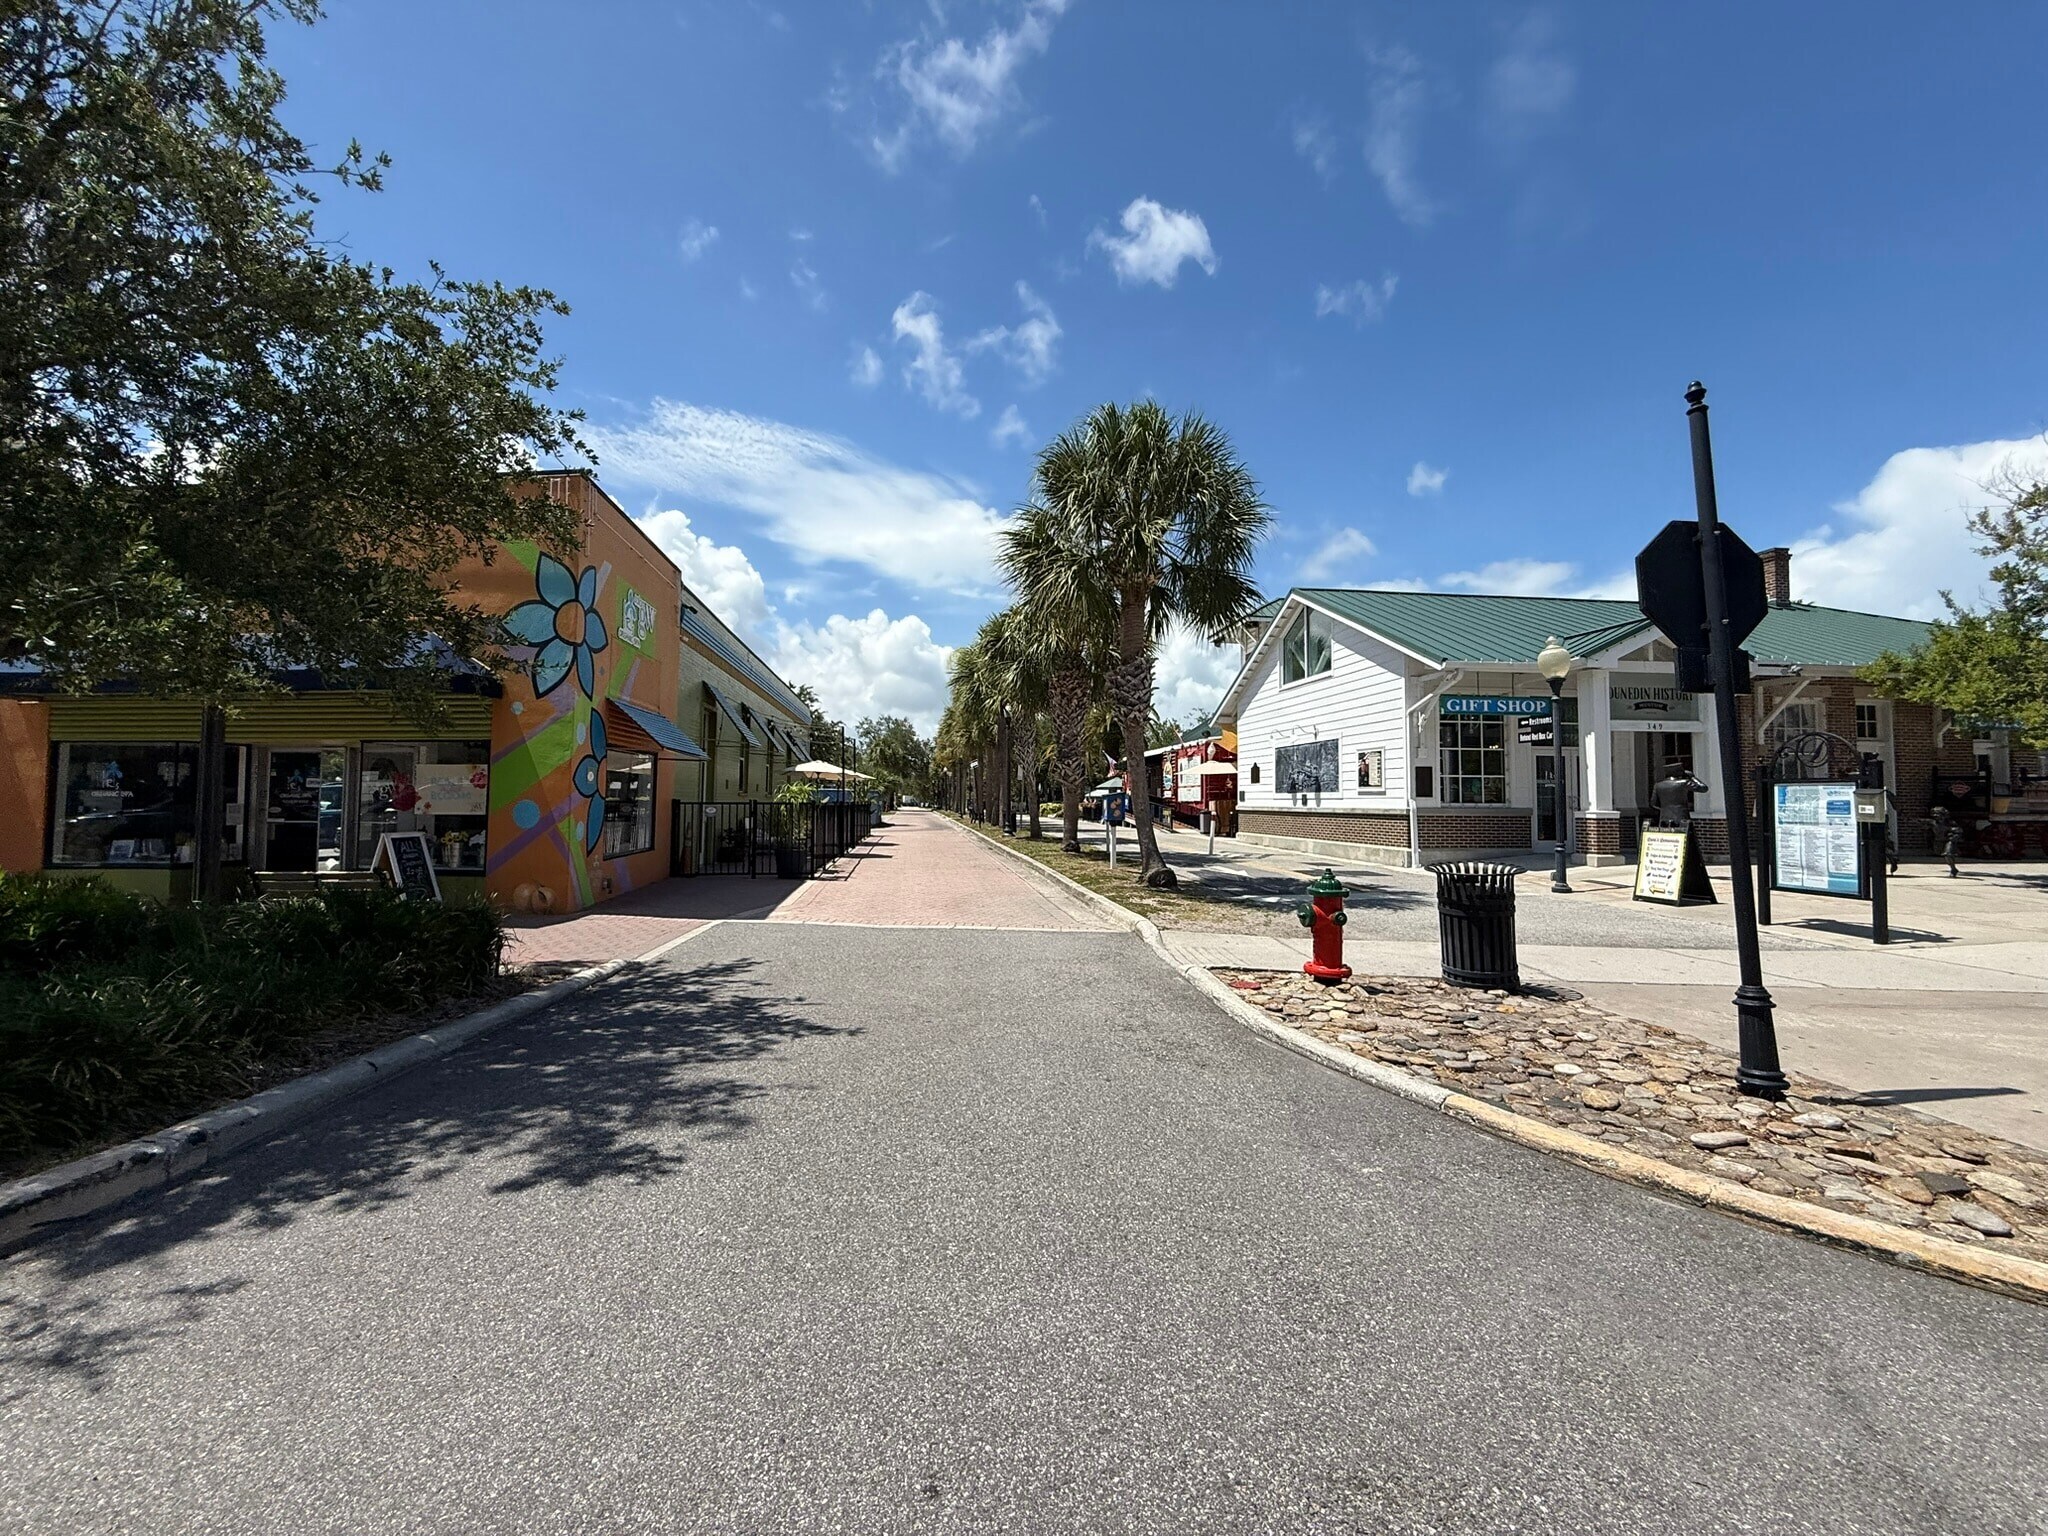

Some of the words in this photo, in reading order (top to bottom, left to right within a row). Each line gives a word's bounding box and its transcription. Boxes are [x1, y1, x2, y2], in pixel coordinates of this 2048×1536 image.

[1446, 698, 1491, 712] GIFT
[1497, 699, 1546, 713] SHOP
[1528, 717, 1553, 726] Restrooms
